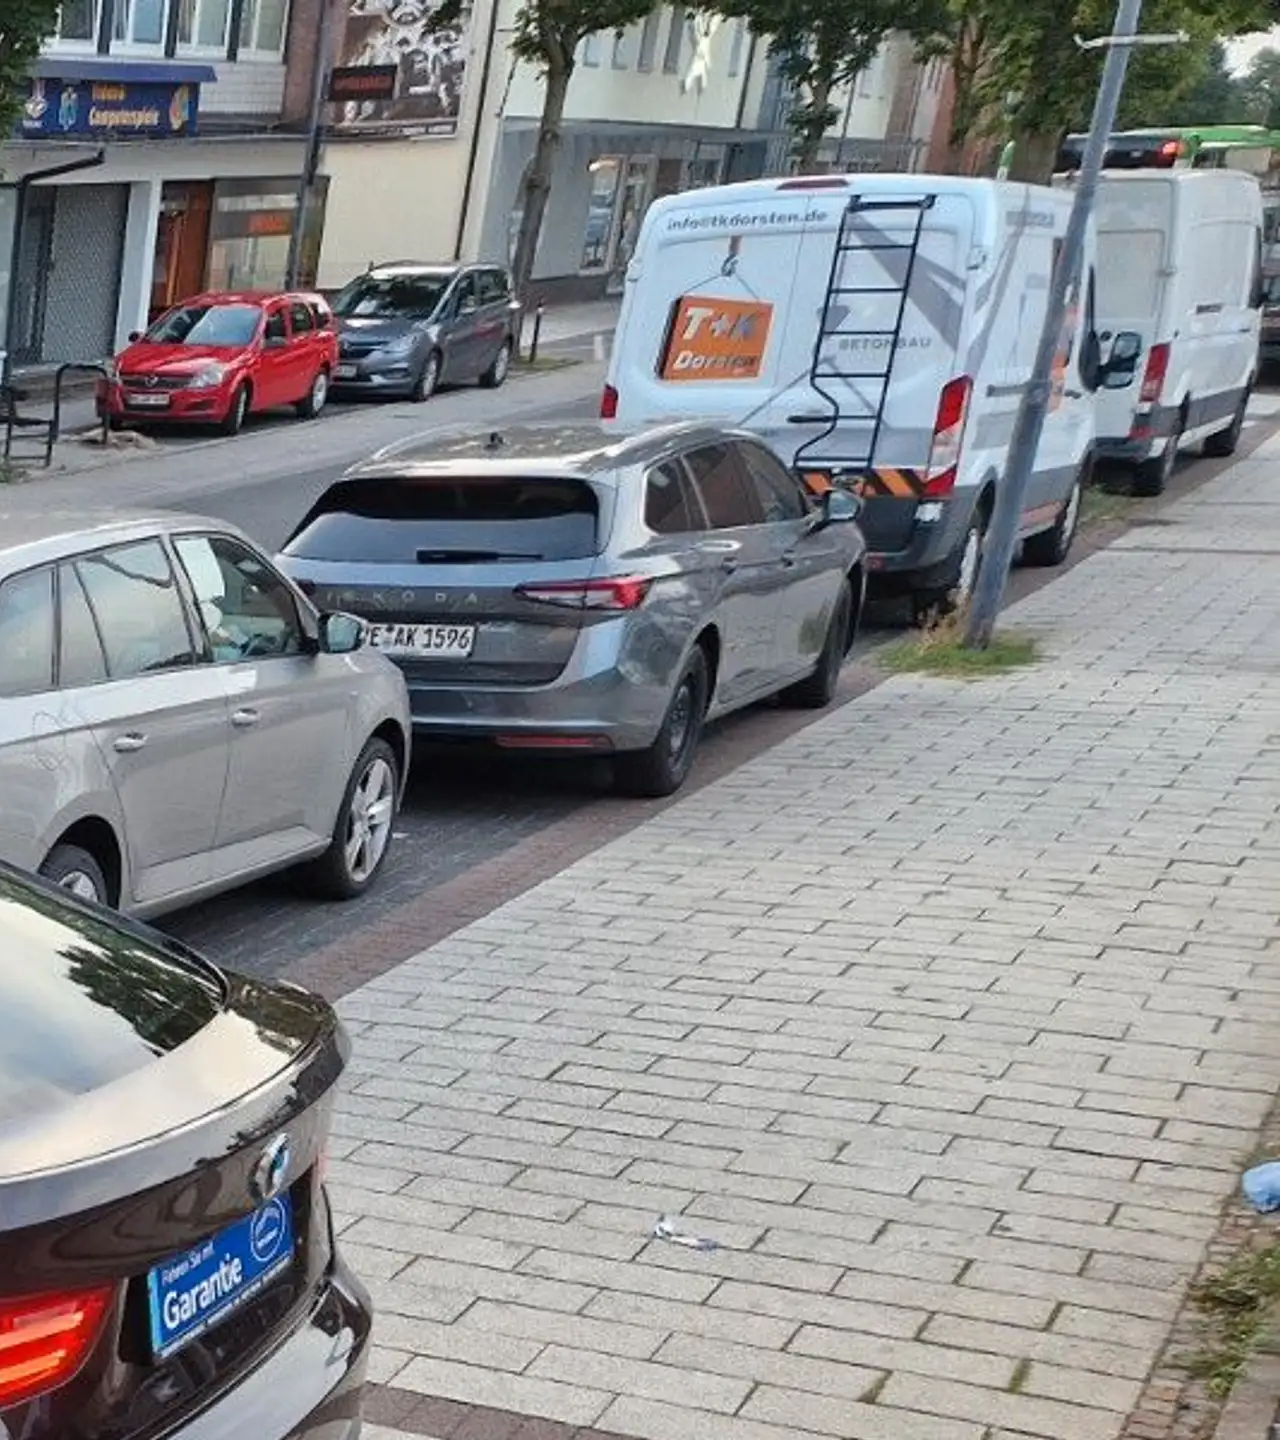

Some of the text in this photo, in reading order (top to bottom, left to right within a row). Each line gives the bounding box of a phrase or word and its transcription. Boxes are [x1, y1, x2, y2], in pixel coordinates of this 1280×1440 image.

[394, 626, 418, 648] AK
[423, 628, 470, 650] 1596
[163, 1253, 243, 1330] Garantie
